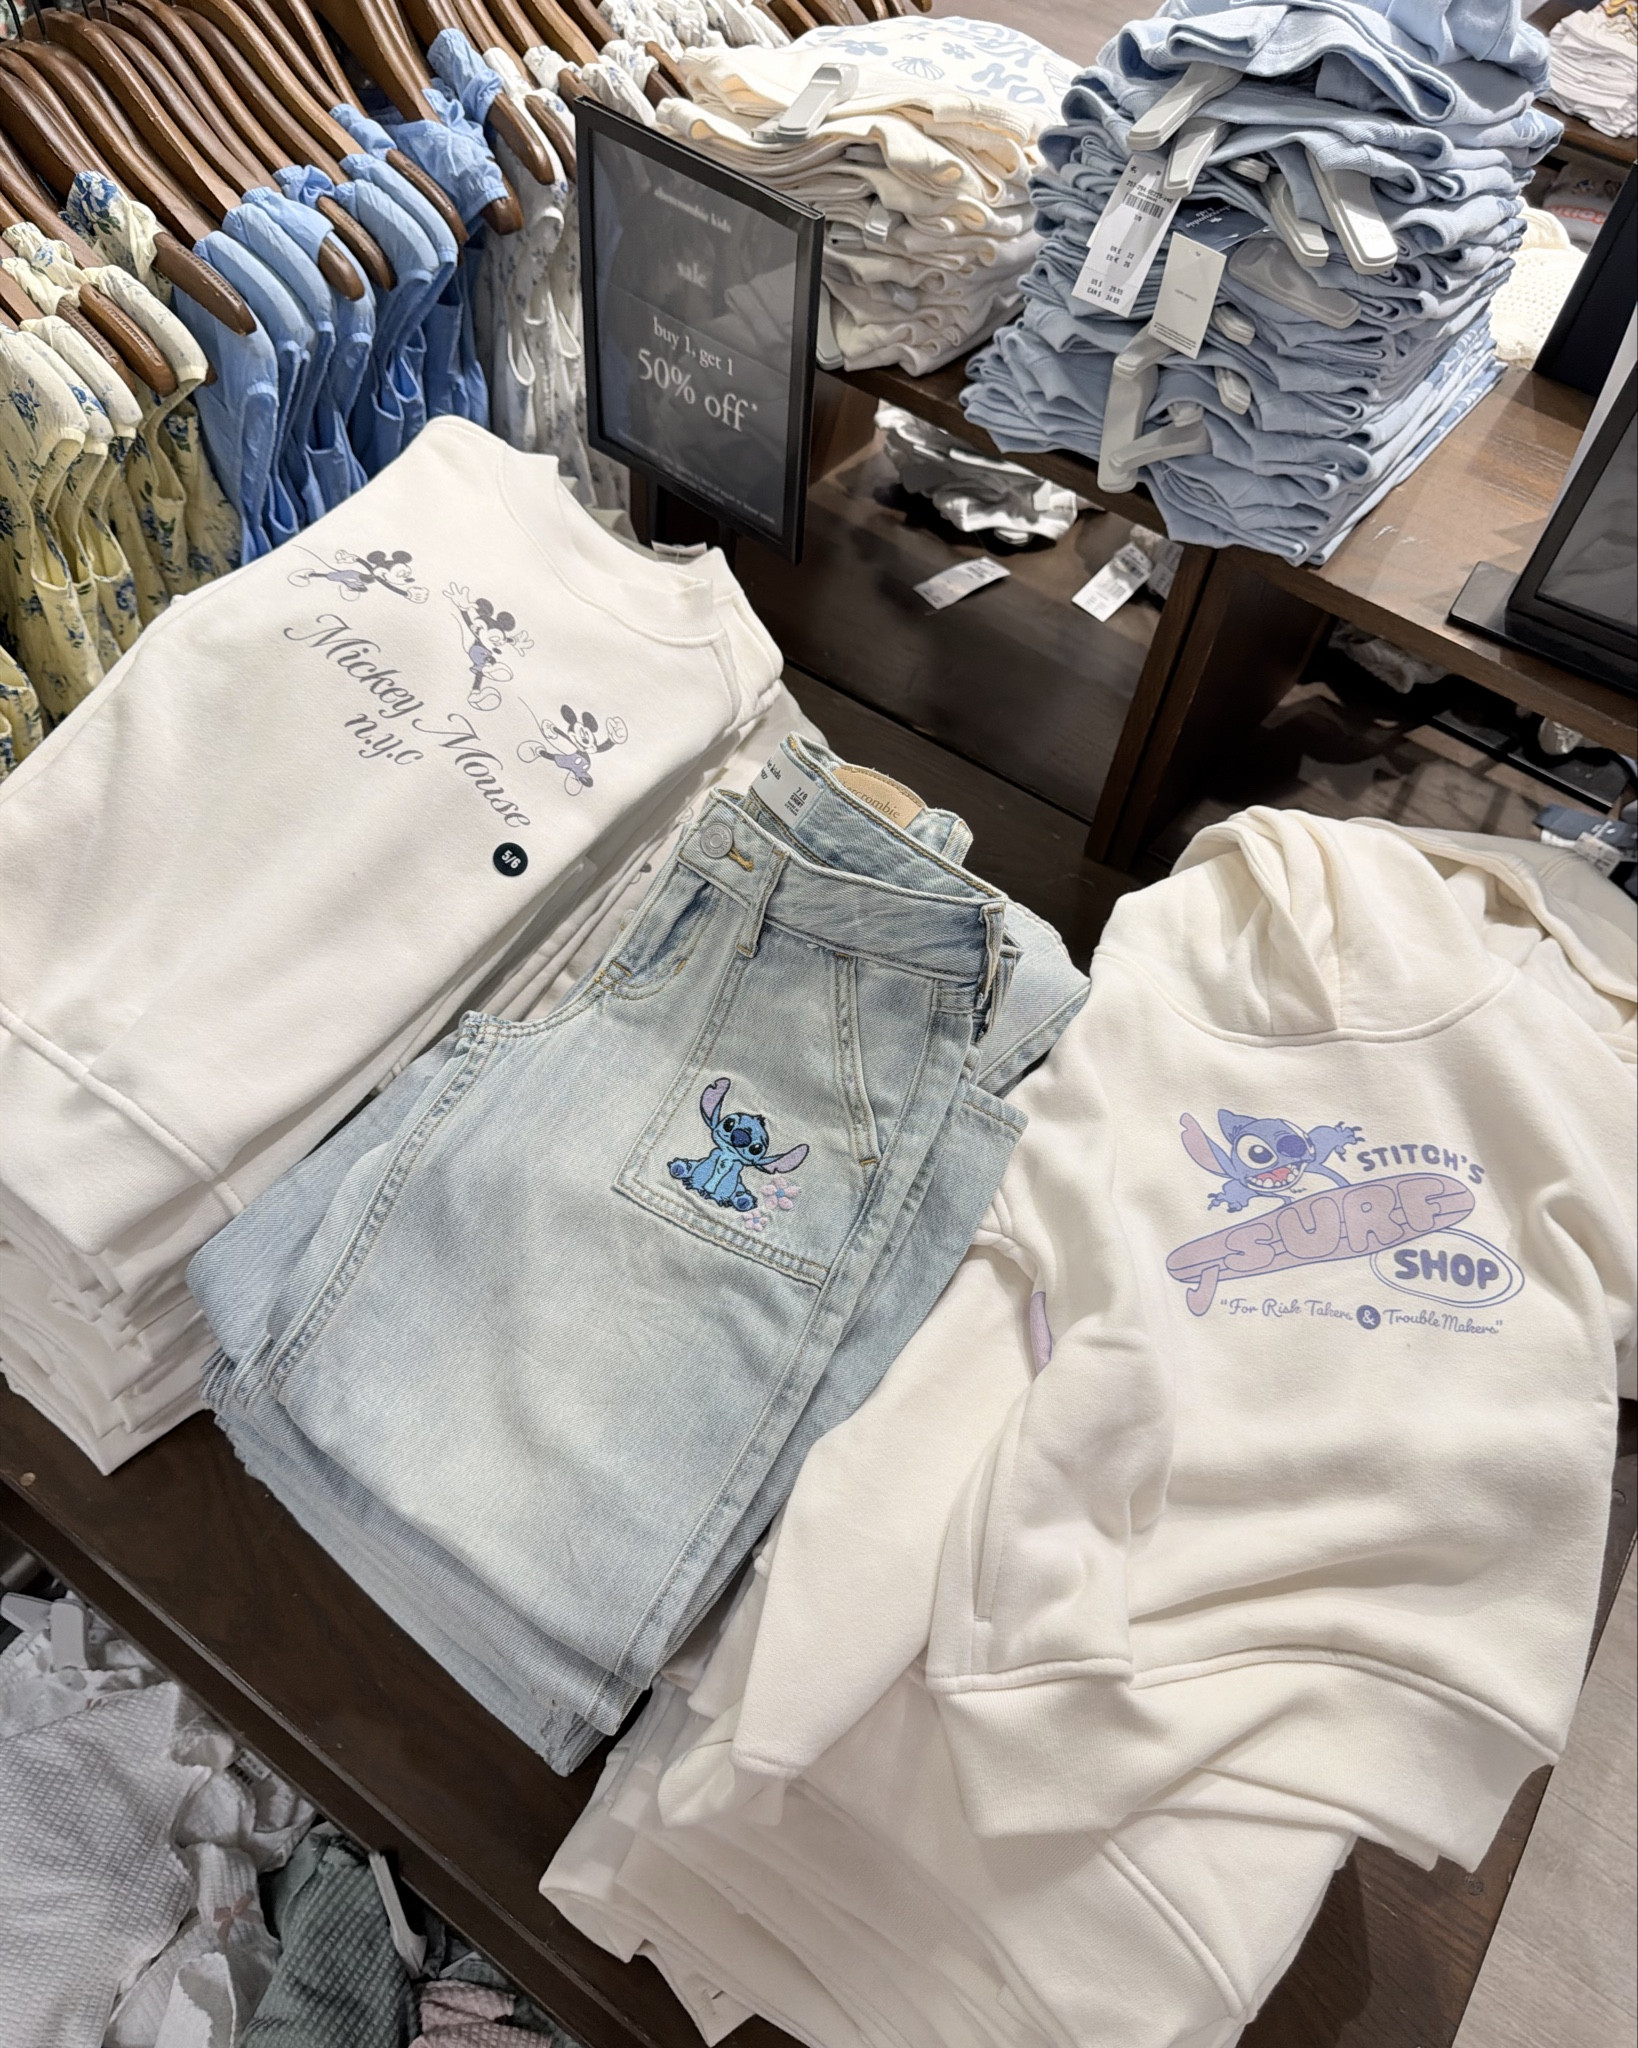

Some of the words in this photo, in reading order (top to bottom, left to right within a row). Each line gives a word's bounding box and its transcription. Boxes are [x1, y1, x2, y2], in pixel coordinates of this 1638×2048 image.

[653, 316, 680, 350] buy
[685, 335, 696, 358] 1,
[699, 348, 722, 370] get
[727, 358, 734, 376] 1
[638, 348, 696, 405] 50%
[284, 613, 424, 719] Mickey
[412, 713, 531, 828] Mouse
[344, 712, 424, 766] n.y.c
[796, 786, 808, 801] 7/8
[501, 849, 522, 869] 5/6
[1356, 1143, 1485, 1185] STITCH'S
[1223, 1176, 1446, 1272] SURF
[1394, 1249, 1500, 1290] SHOP
[1262, 1297, 1302, 1318] Risk
[1382, 1308, 1440, 1327] Trouble
